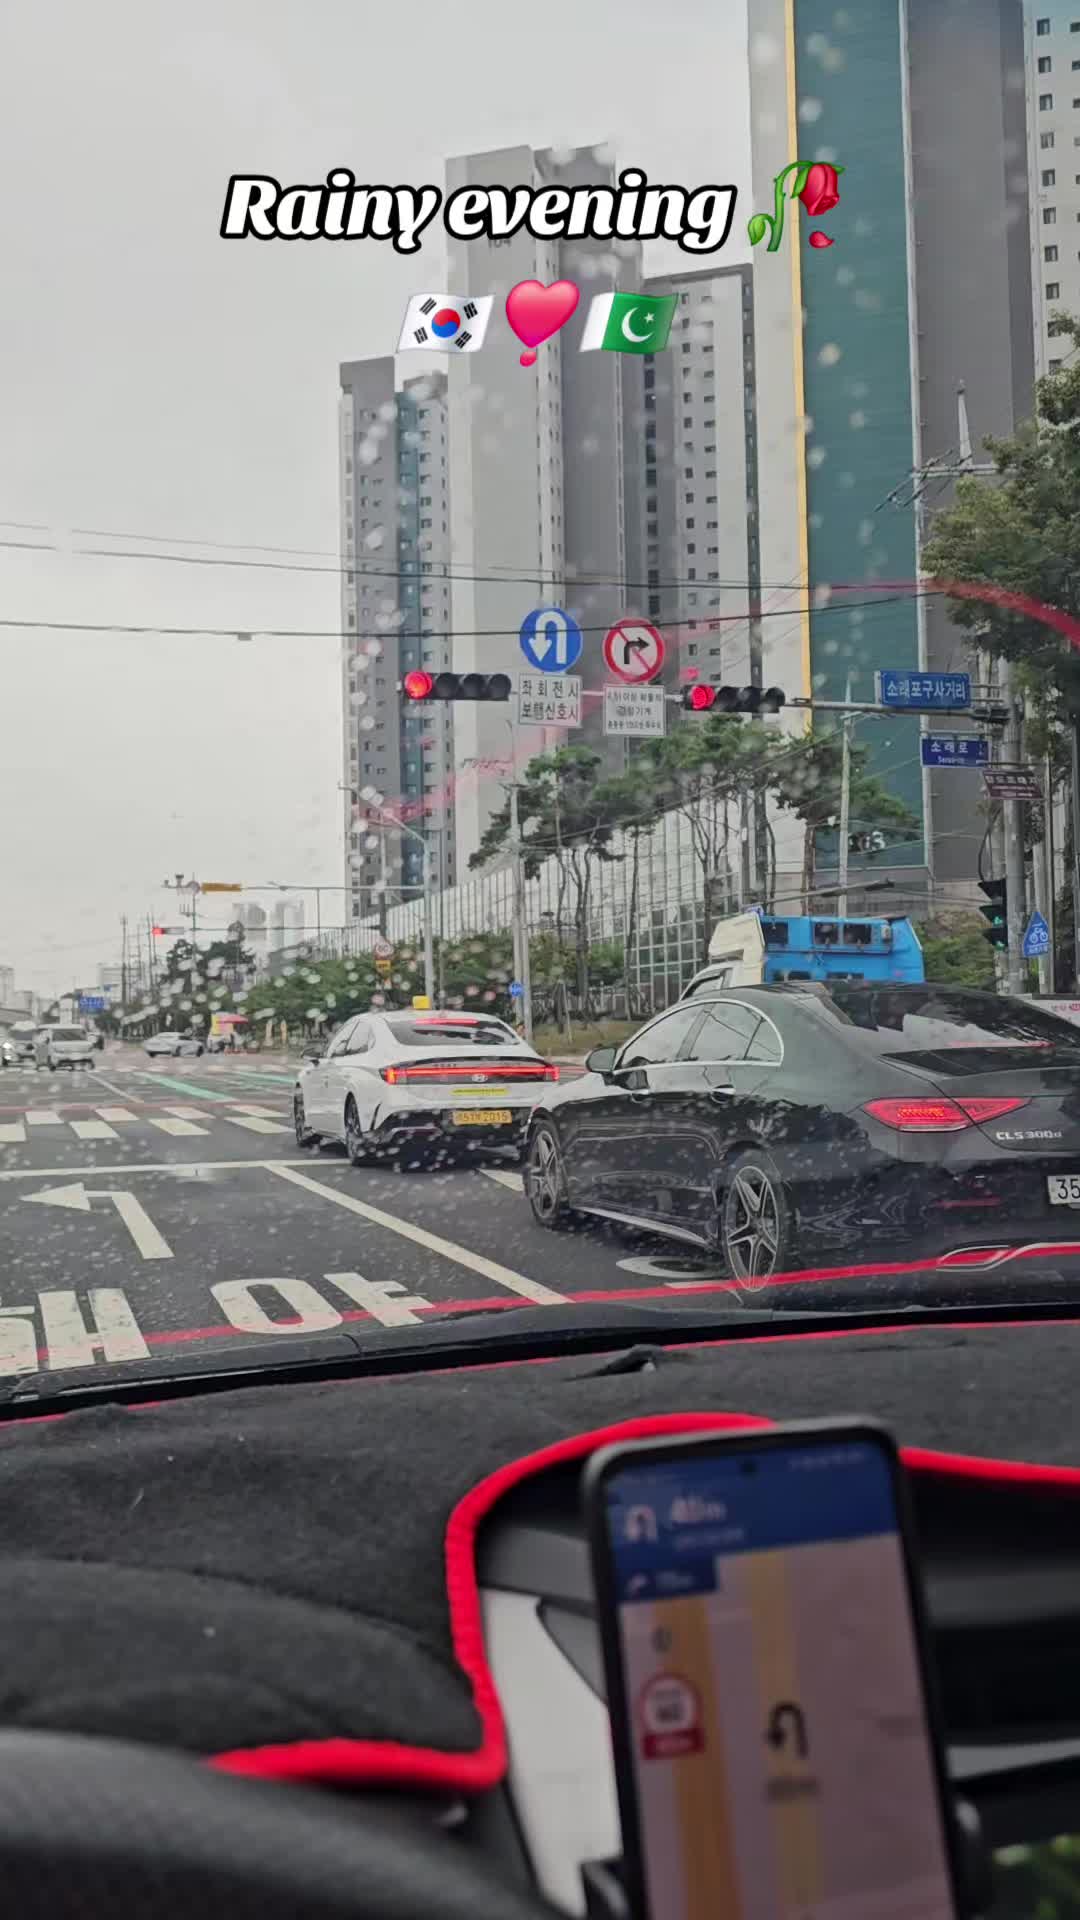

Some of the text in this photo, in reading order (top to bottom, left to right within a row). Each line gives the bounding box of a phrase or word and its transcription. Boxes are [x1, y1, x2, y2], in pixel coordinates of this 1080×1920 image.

[886, 679, 966, 699] 소래포구사거리
[521, 703, 578, 721] 보행신호시
[930, 741, 969, 753] 소래로
[1057, 1178, 1080, 1199] 35
